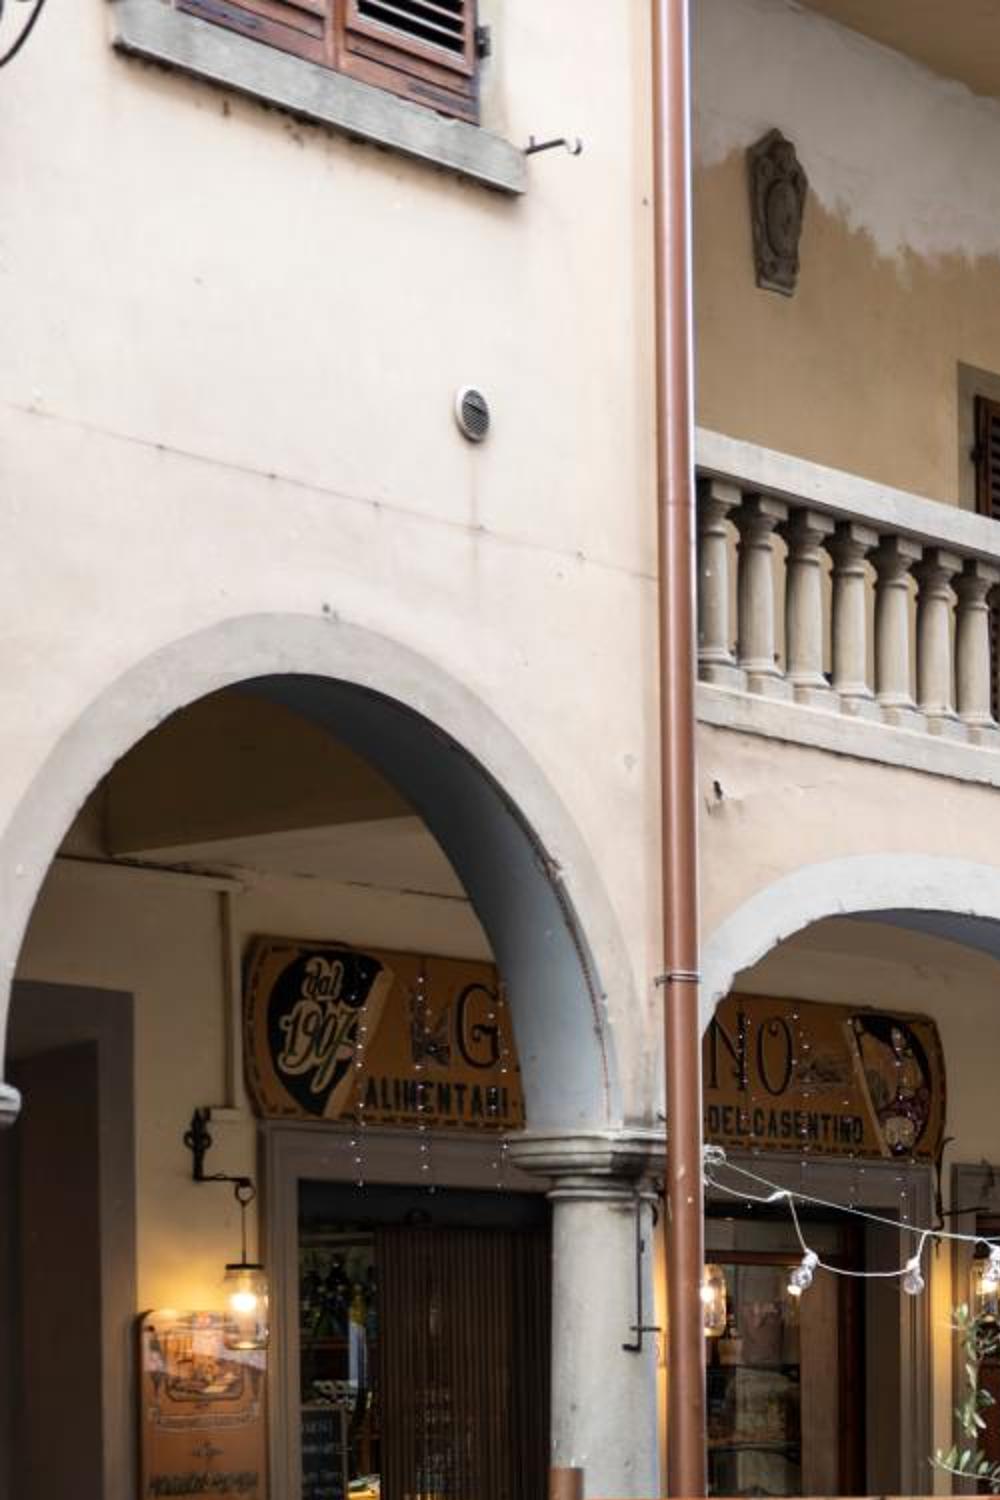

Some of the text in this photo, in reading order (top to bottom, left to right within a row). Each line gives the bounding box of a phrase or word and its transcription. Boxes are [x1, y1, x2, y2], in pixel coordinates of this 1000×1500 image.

[364, 1076, 509, 1119] ALIMENTARI
[706, 1106, 865, 1144] DEL CASENTINO
